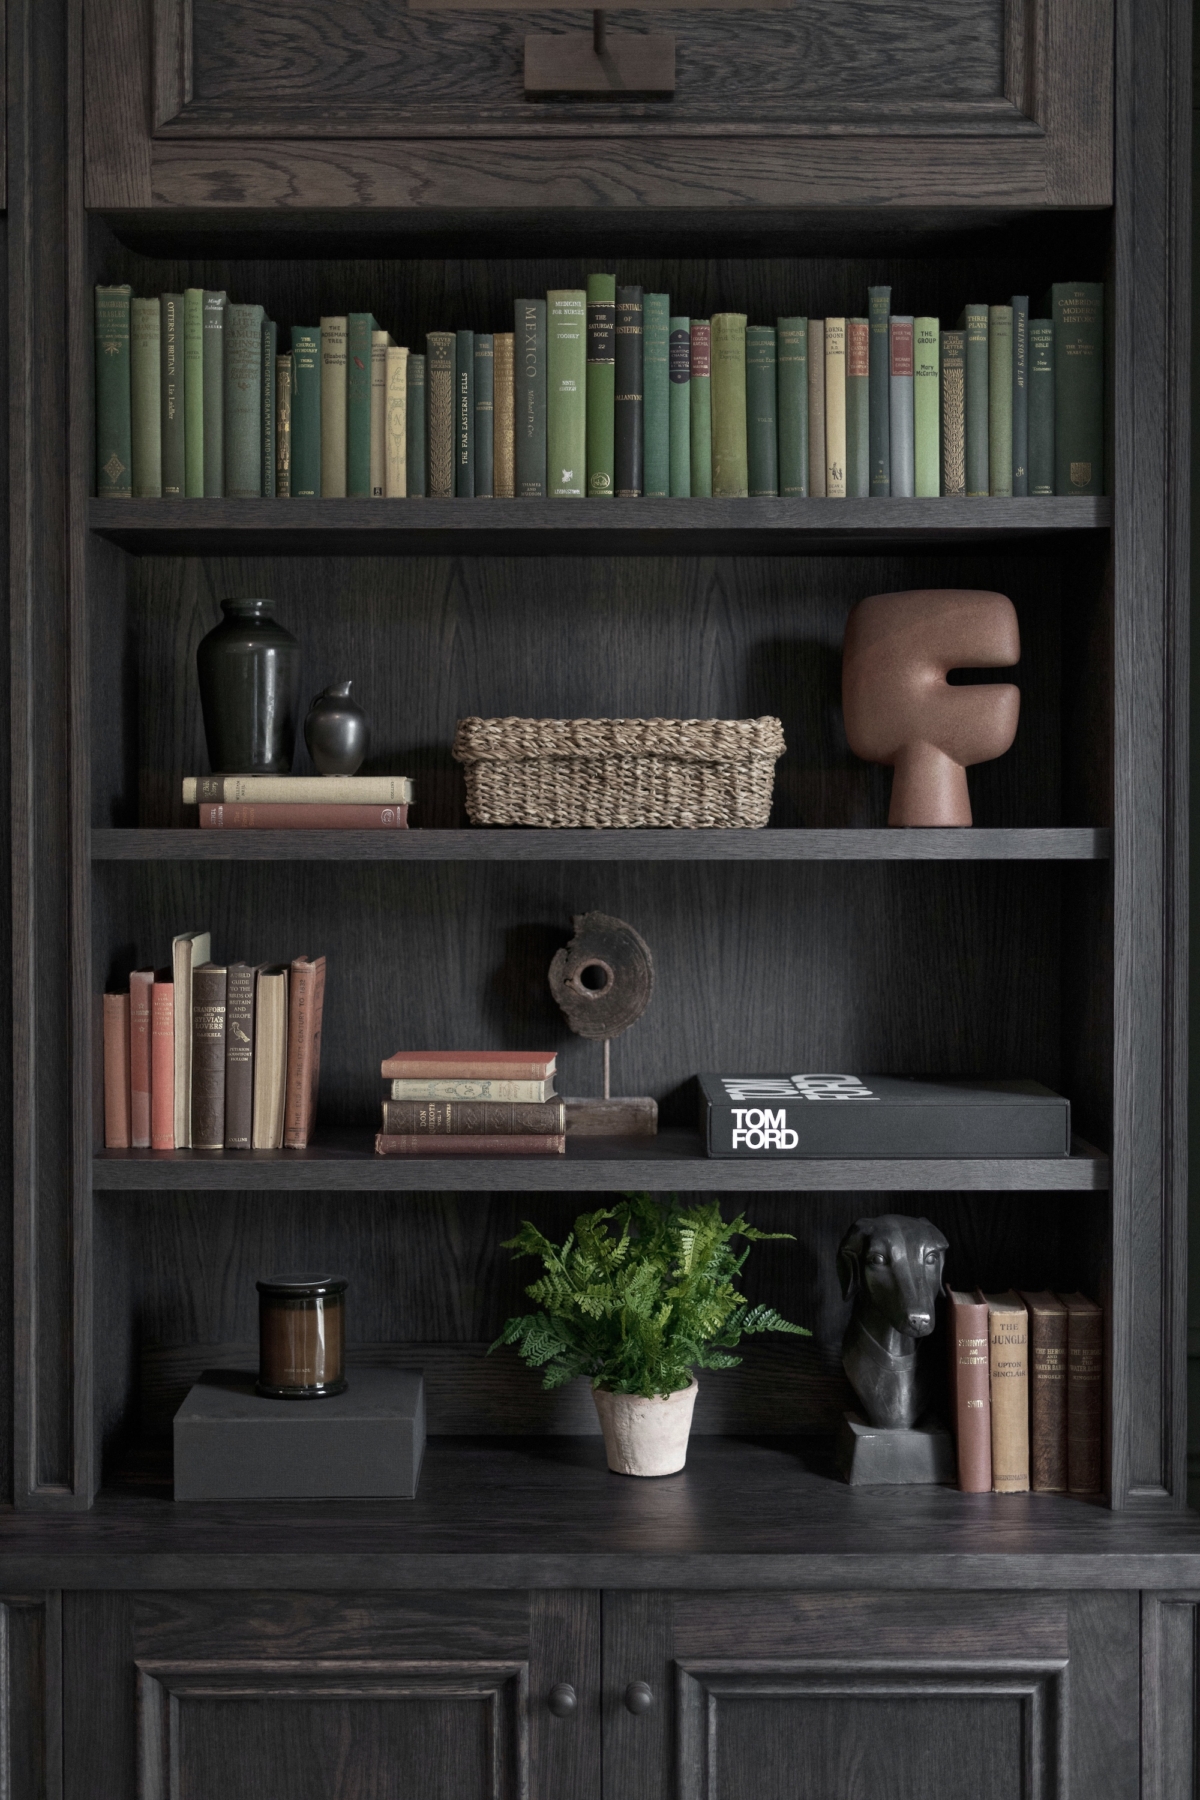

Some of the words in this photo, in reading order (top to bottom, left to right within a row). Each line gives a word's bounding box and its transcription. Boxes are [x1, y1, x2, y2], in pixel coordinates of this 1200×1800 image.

[167, 302, 175, 332] OTTERS
[167, 334, 175, 343] IN
[525, 306, 536, 378] MEXICO
[167, 345, 176, 376] BRITAIN
[210, 782, 218, 797] Story
[296, 1080, 302, 1090] OF
[299, 998, 304, 1007] TO
[721, 1078, 804, 1100] TOM
[791, 1074, 881, 1100] FORD
[731, 1108, 786, 1129] TOM
[732, 1128, 800, 1150] FORD
[958, 1338, 987, 1346] SYNONYMS
[992, 1334, 1027, 1345] JUNGLE
